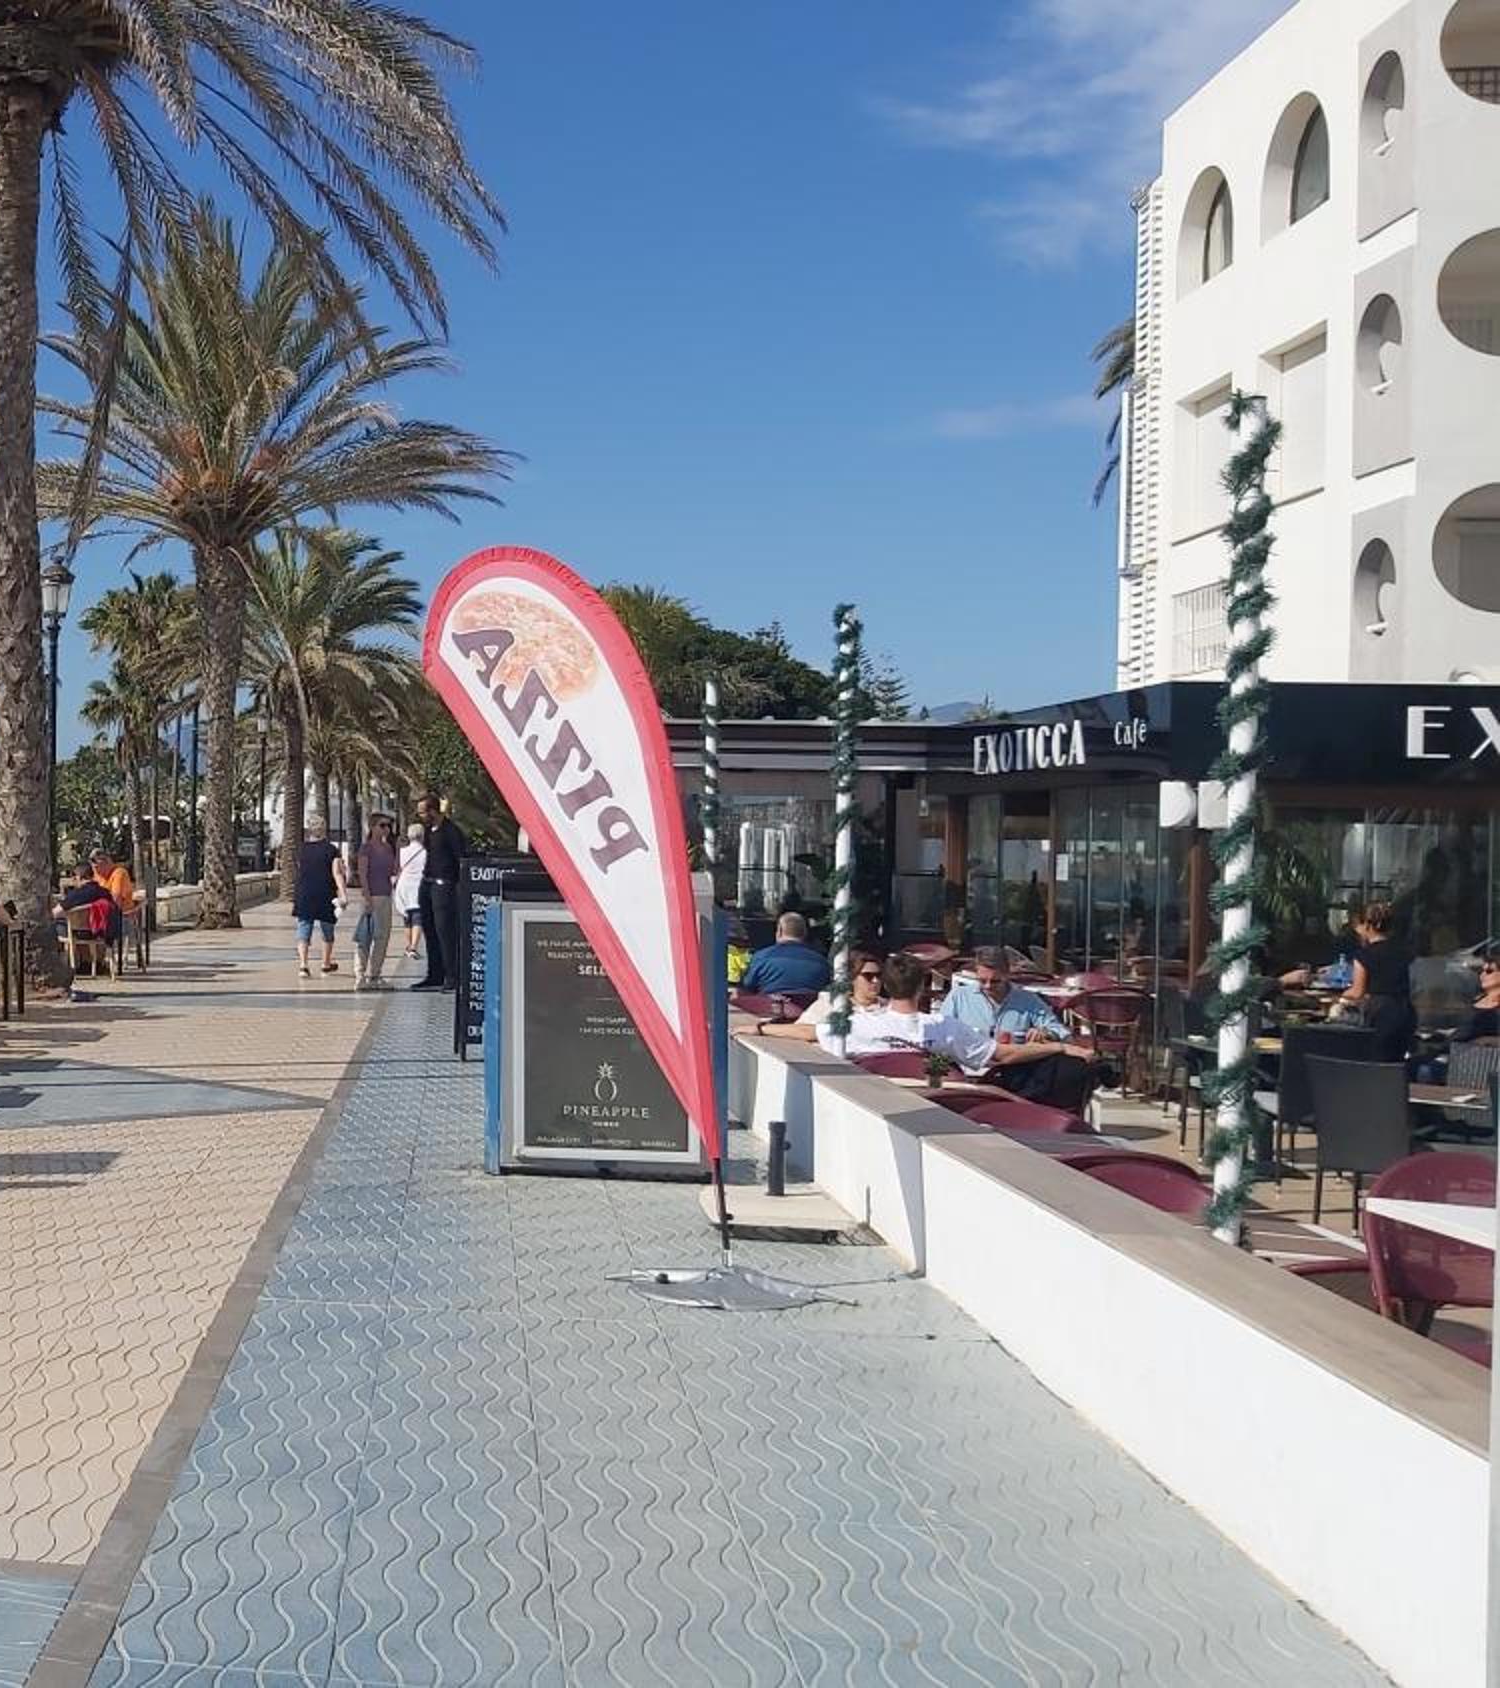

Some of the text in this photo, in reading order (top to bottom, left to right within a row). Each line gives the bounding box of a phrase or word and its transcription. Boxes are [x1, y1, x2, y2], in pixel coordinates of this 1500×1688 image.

[973, 717, 1148, 775] EXOTICCA Café
[563, 1105, 650, 1119] PINEAPPLE
